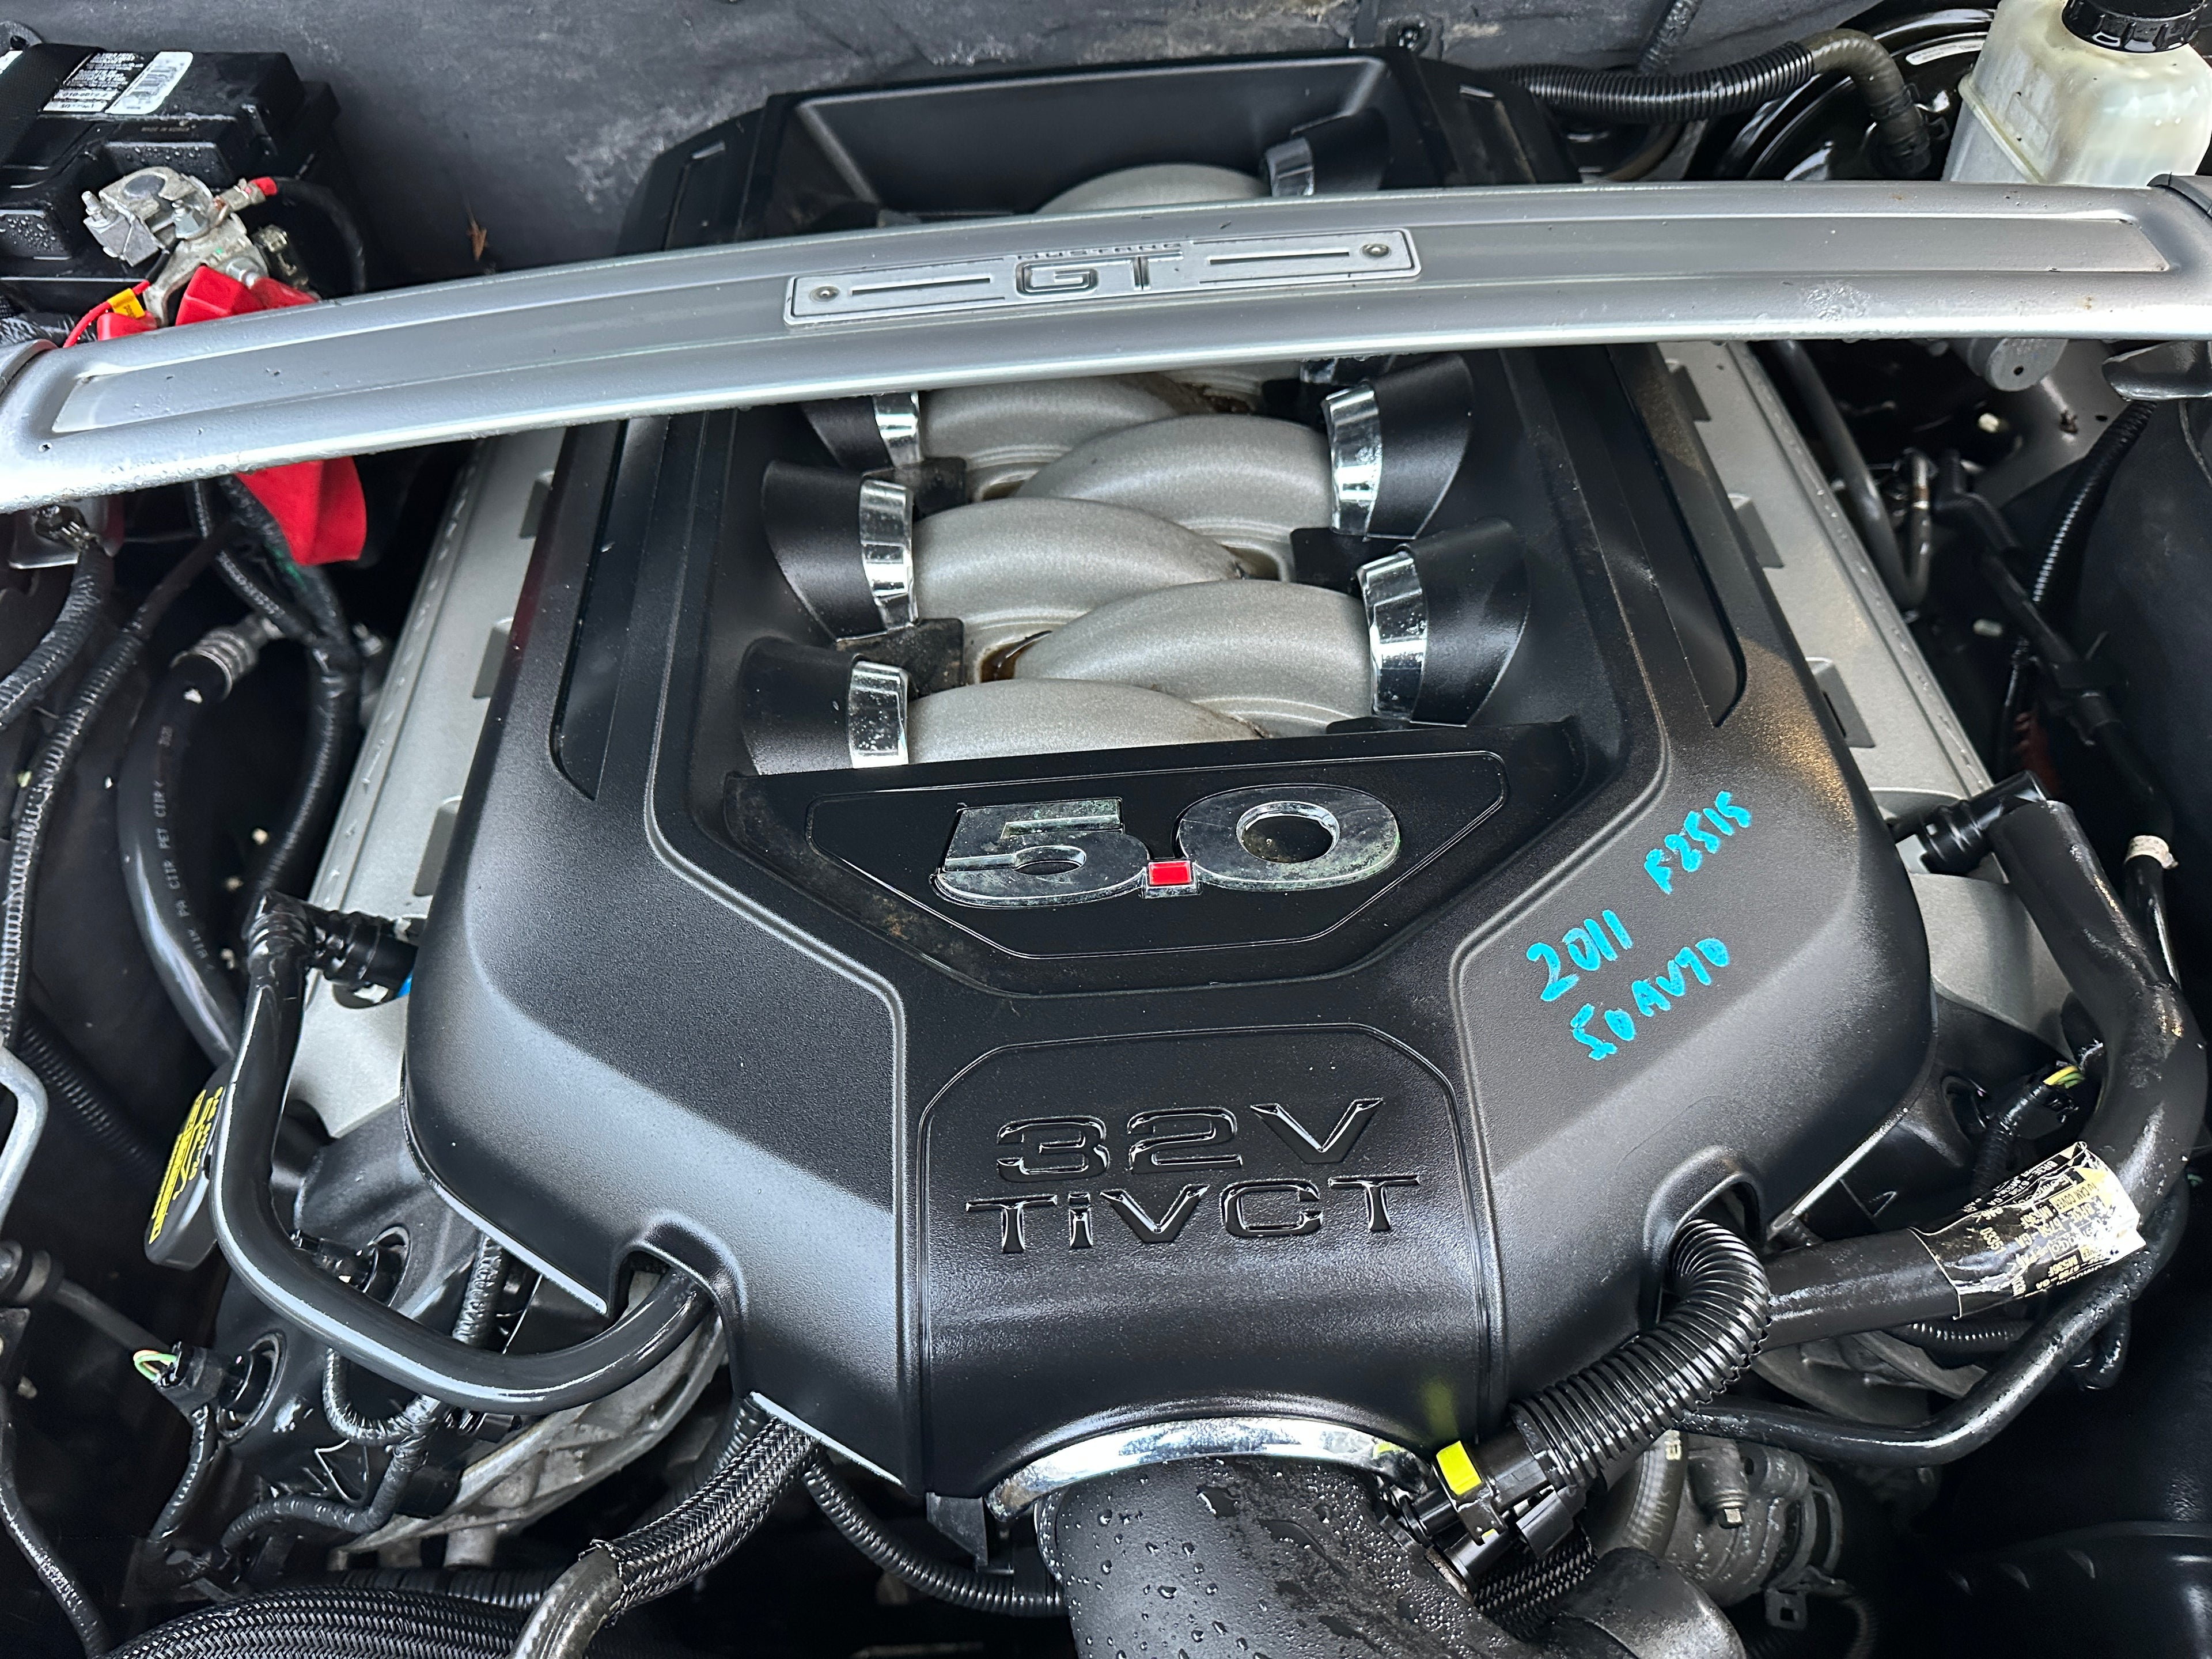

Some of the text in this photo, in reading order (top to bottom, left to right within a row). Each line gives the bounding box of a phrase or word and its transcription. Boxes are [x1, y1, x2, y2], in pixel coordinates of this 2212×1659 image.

[1015, 251, 1184, 298] GT
[930, 783, 1401, 909] 5.0
[1527, 910, 1633, 1002] 2011
[996, 1098, 1384, 1183] 32V
[965, 1174, 1421, 1254] TiVCT
[2052, 1194, 2074, 1210] COVER
[2073, 1186, 2090, 1203] CAM
[1979, 1227, 2006, 1255] 03351
[2047, 1255, 2078, 1276] M536F
